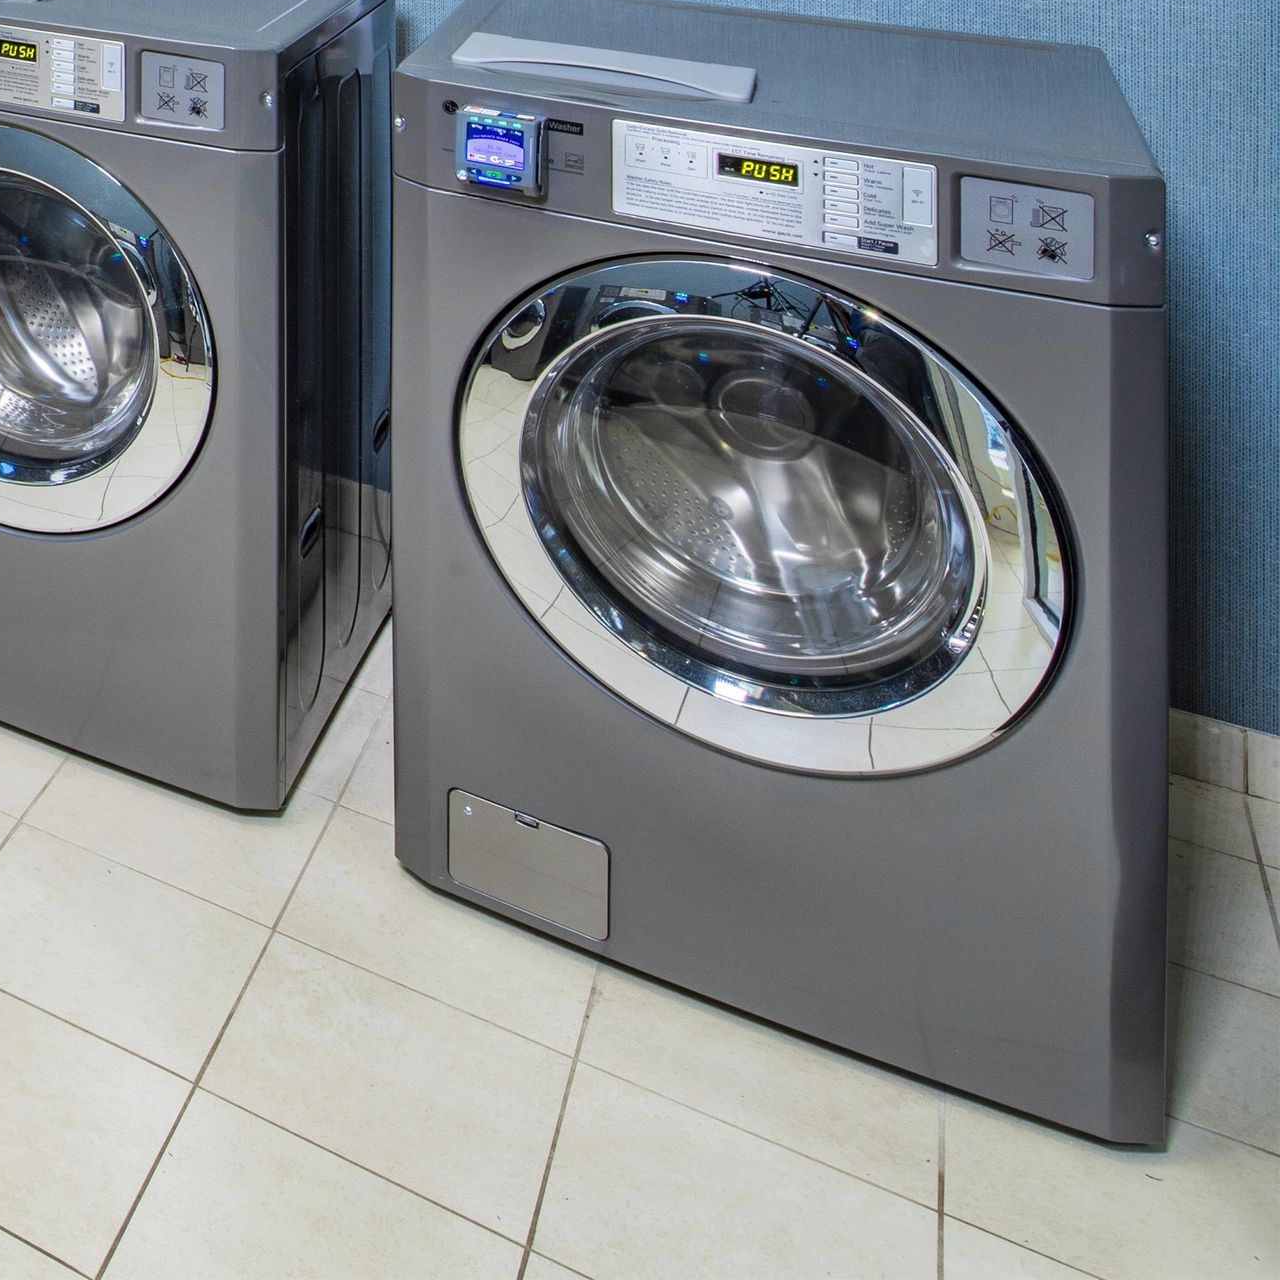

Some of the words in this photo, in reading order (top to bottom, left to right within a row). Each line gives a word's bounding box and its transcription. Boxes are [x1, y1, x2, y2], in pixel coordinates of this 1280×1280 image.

[1, 43, 35, 59] PUSH
[549, 120, 581, 133] Washer
[651, 136, 680, 145] Processing
[757, 152, 785, 161] Remaining
[741, 161, 794, 182] PUSH
[864, 177, 883, 185] Warm
[864, 206, 892, 215] Delicates
[877, 221, 895, 229] Super
